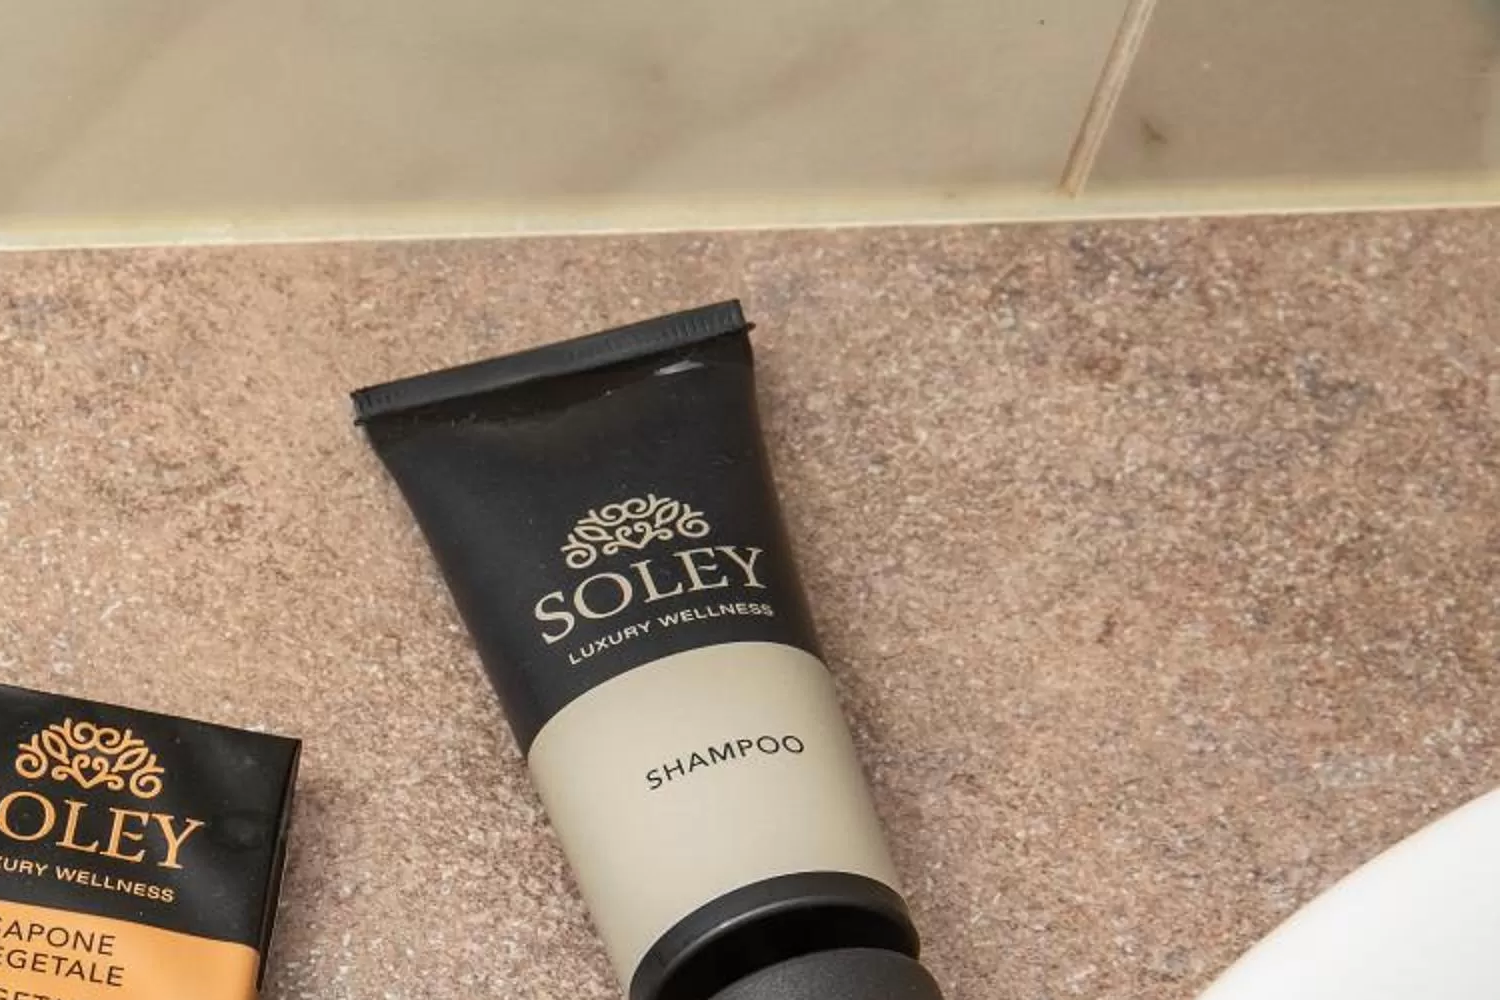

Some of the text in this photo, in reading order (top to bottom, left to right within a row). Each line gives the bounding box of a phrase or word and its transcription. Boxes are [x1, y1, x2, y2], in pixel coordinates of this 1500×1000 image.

[534, 545, 767, 644] SOLEY
[568, 602, 774, 665] LUXURY WELLNESS
[646, 735, 804, 790] SHAMPOO
[55, 865, 175, 903] WELLNESS
